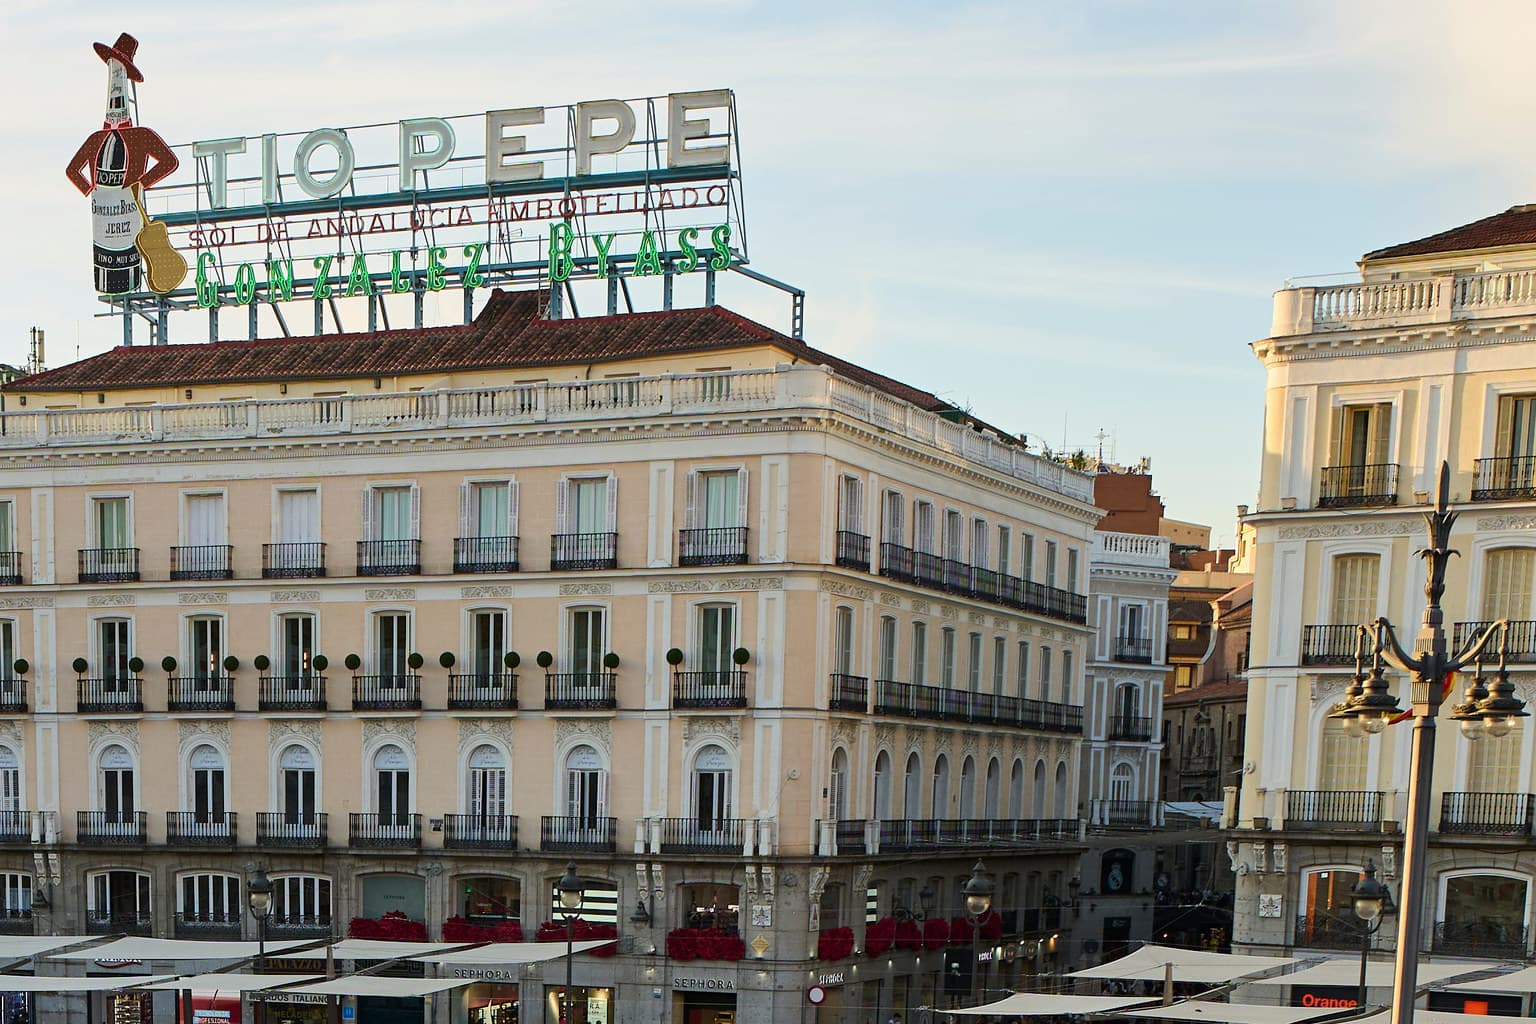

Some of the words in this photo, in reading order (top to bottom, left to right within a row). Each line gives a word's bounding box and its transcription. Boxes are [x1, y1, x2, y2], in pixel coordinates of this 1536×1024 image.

[192, 127, 356, 209] TIO
[399, 88, 731, 192] PEPE
[189, 226, 238, 250] SOL
[257, 221, 290, 243] DE
[306, 204, 474, 239] ANDALUCIA
[488, 184, 726, 224] EMBOTELLADO
[105, 221, 131, 235] JEREZ
[196, 242, 485, 308] GONZALEZ
[547, 222, 732, 282] BYASS
[454, 968, 513, 980] SEPHORA
[674, 977, 735, 990] SEPHORA
[1302, 993, 1358, 1008] Orange
